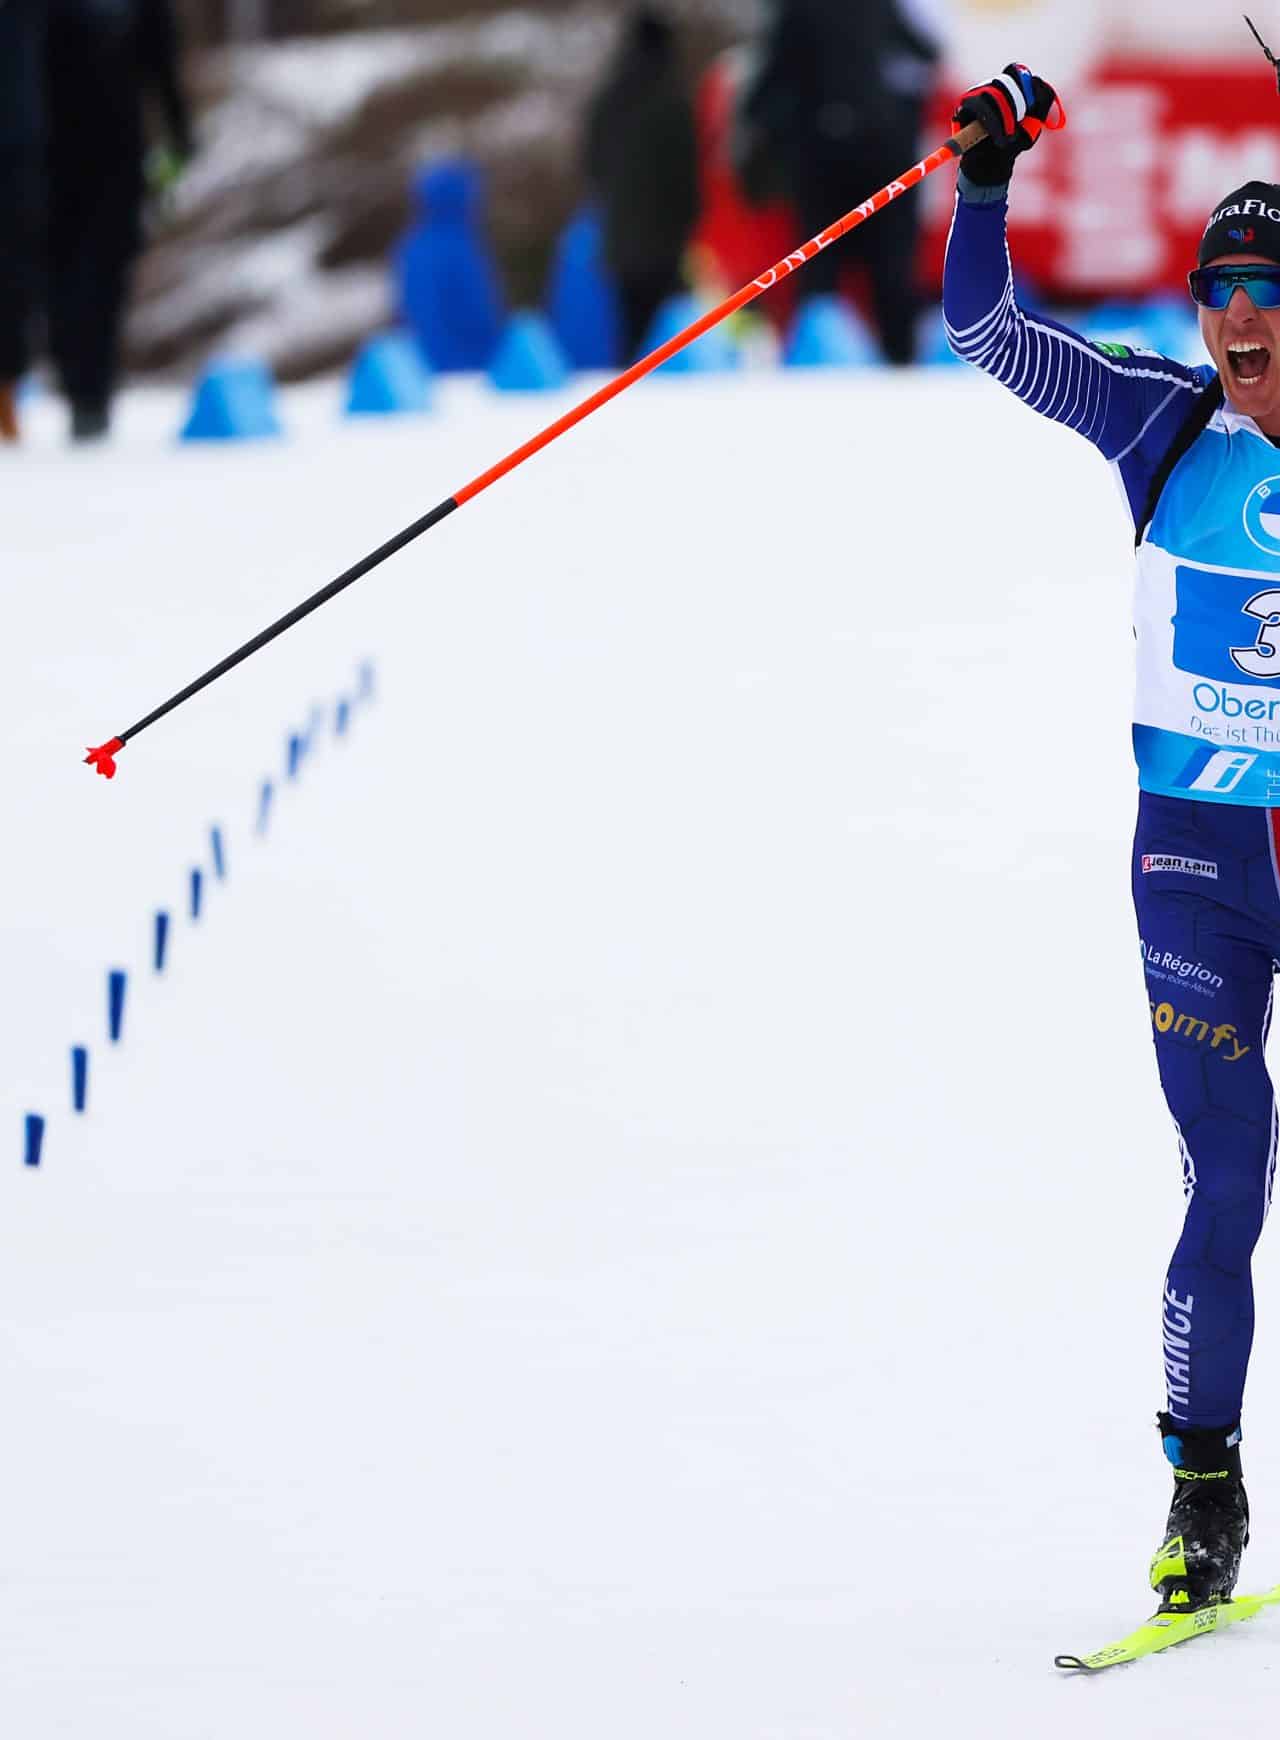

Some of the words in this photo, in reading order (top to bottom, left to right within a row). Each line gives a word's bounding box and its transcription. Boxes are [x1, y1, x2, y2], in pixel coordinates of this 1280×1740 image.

[1226, 724, 1247, 743] ist
[1147, 945, 1160, 964] La
[1161, 951, 1224, 988] Région
[1150, 1002, 1250, 1061] omfy
